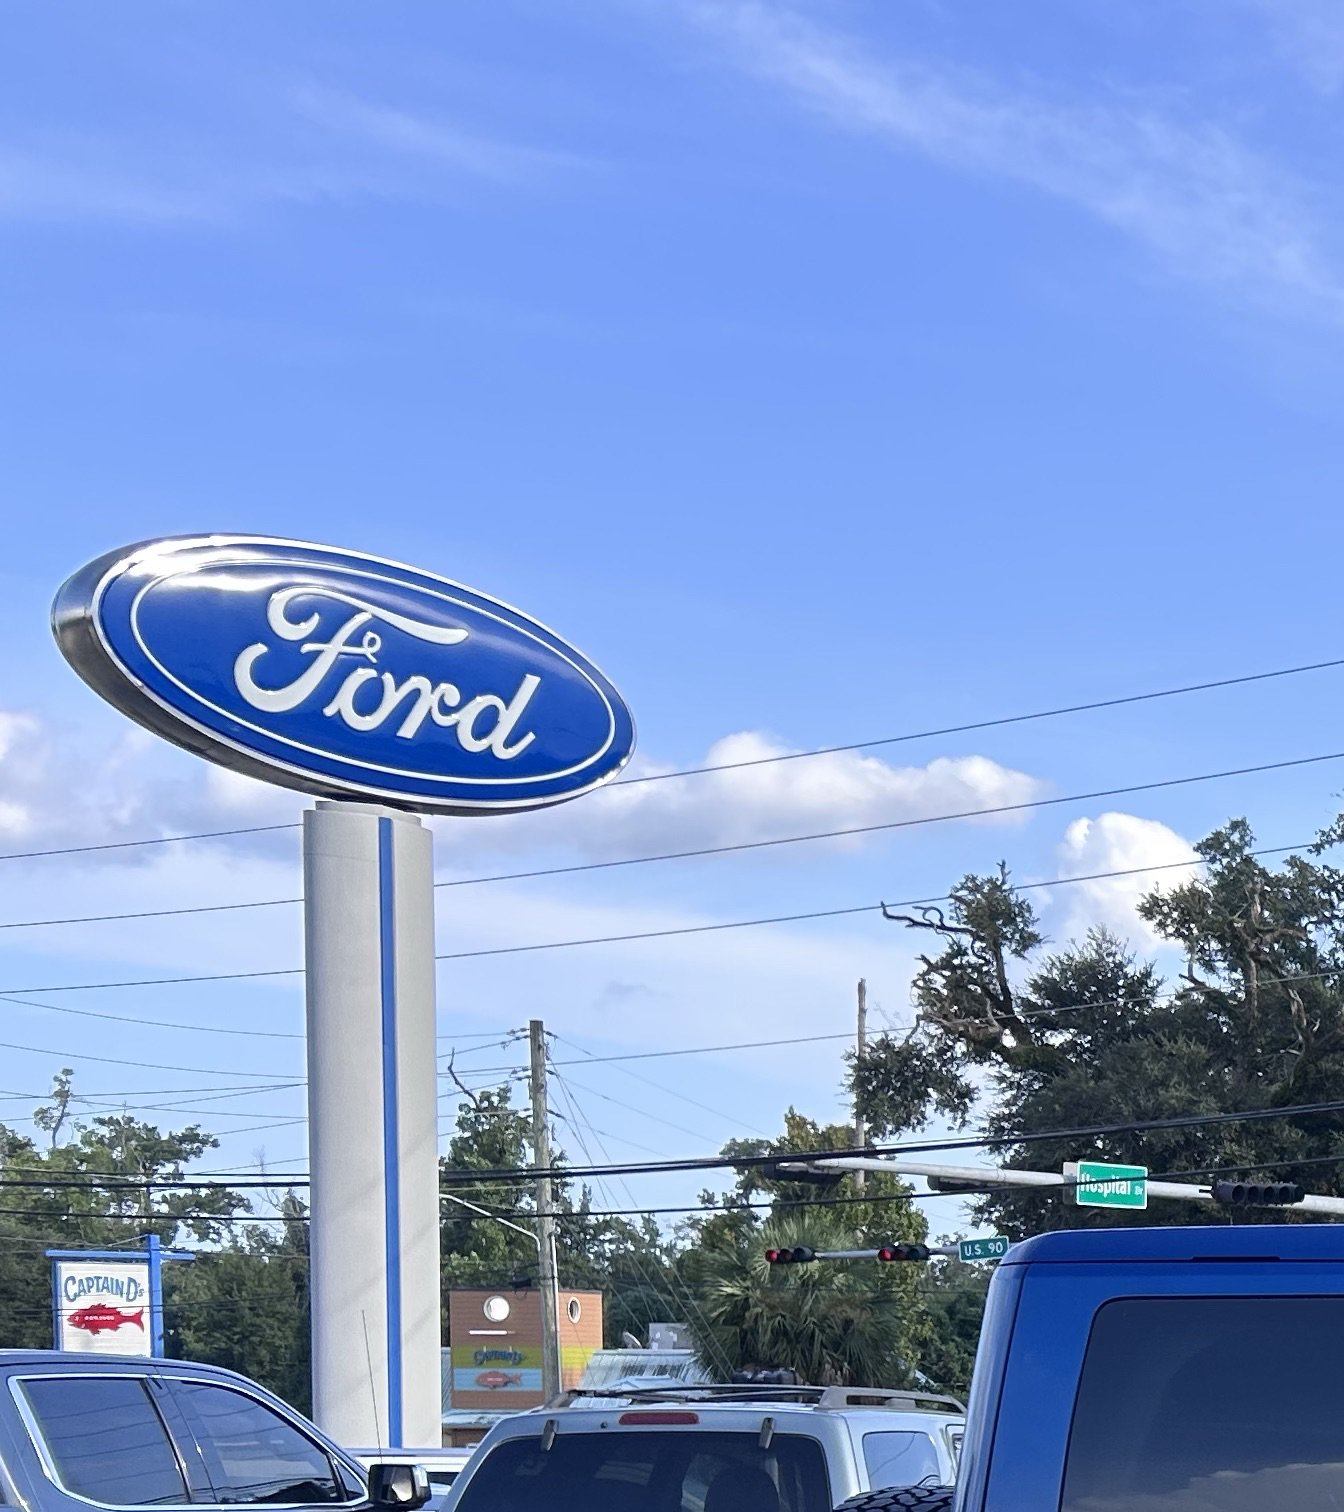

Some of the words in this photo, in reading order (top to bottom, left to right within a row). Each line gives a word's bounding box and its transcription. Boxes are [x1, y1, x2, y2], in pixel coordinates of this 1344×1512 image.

[233, 586, 542, 760] Ford
[1081, 1173, 1131, 1198] Hospital
[965, 1244, 984, 1257] U.S.
[988, 1241, 1004, 1254] 90
[64, 1275, 124, 1303] CAPTAIN
